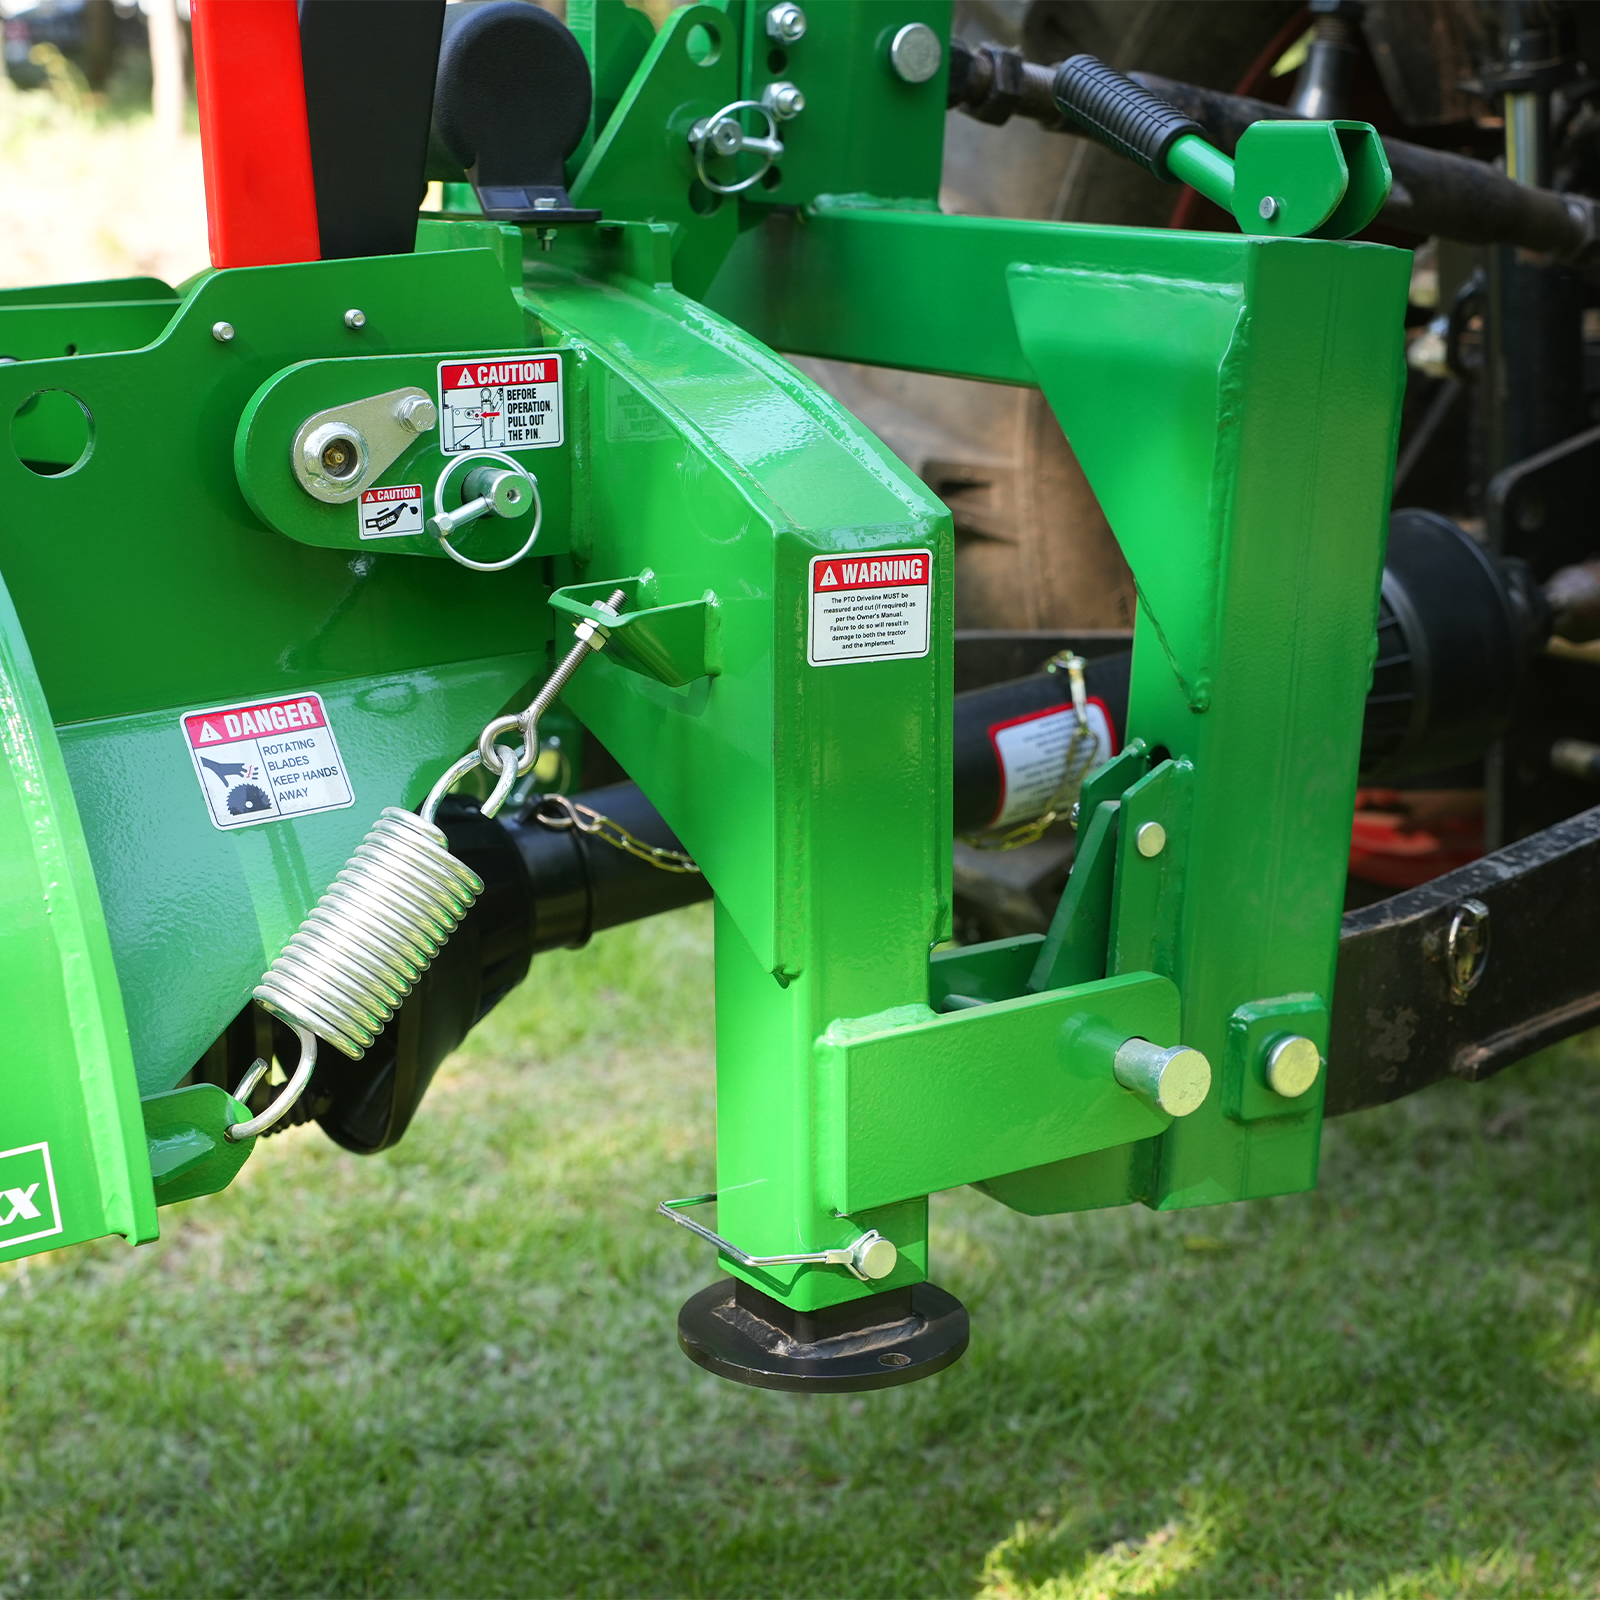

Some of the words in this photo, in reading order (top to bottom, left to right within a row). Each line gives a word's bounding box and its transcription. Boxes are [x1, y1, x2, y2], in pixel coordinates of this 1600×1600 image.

[477, 363, 545, 384] CAUTION
[507, 388, 536, 401] BEFORE
[508, 417, 527, 427] PULL
[530, 415, 544, 426] OUT
[508, 430, 522, 441] THE
[526, 429, 541, 439] PIN.
[377, 488, 415, 500] CAUTION
[842, 559, 922, 584] WARNING
[882, 601, 908, 609] required)
[864, 640, 895, 648] implement.
[224, 702, 317, 738] DANGER
[263, 738, 315, 755] ROTATING
[268, 756, 309, 771] BLADES
[273, 773, 300, 786] KEEP
[303, 766, 338, 780] HANDS
[279, 788, 308, 801] AWAY
